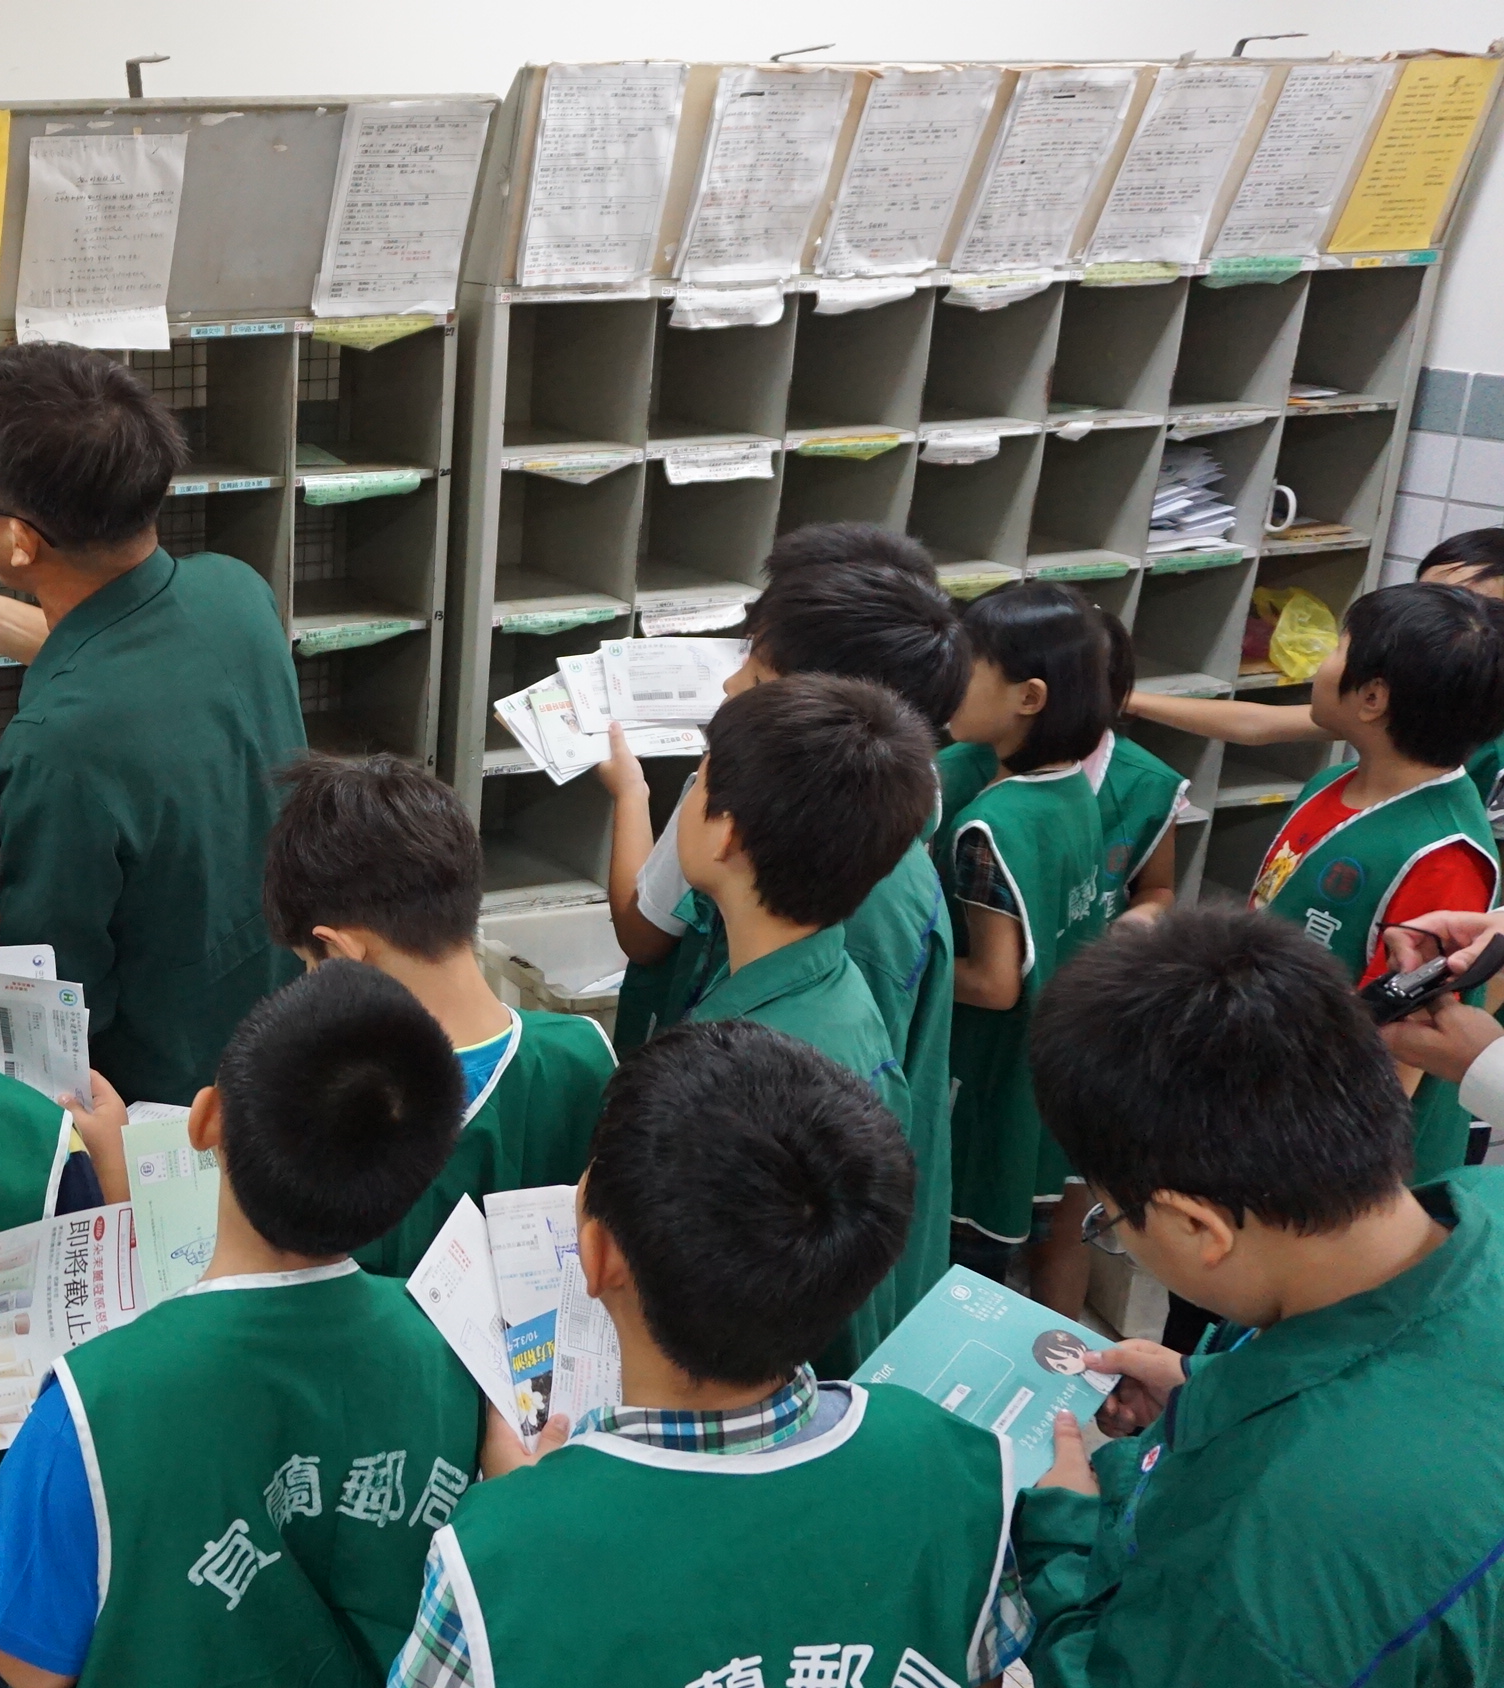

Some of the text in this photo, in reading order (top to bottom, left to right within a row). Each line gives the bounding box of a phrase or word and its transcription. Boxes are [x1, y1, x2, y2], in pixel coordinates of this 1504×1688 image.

[798, 281, 807, 289] 30
[662, 287, 671, 295] 29
[501, 293, 511, 302] 28
